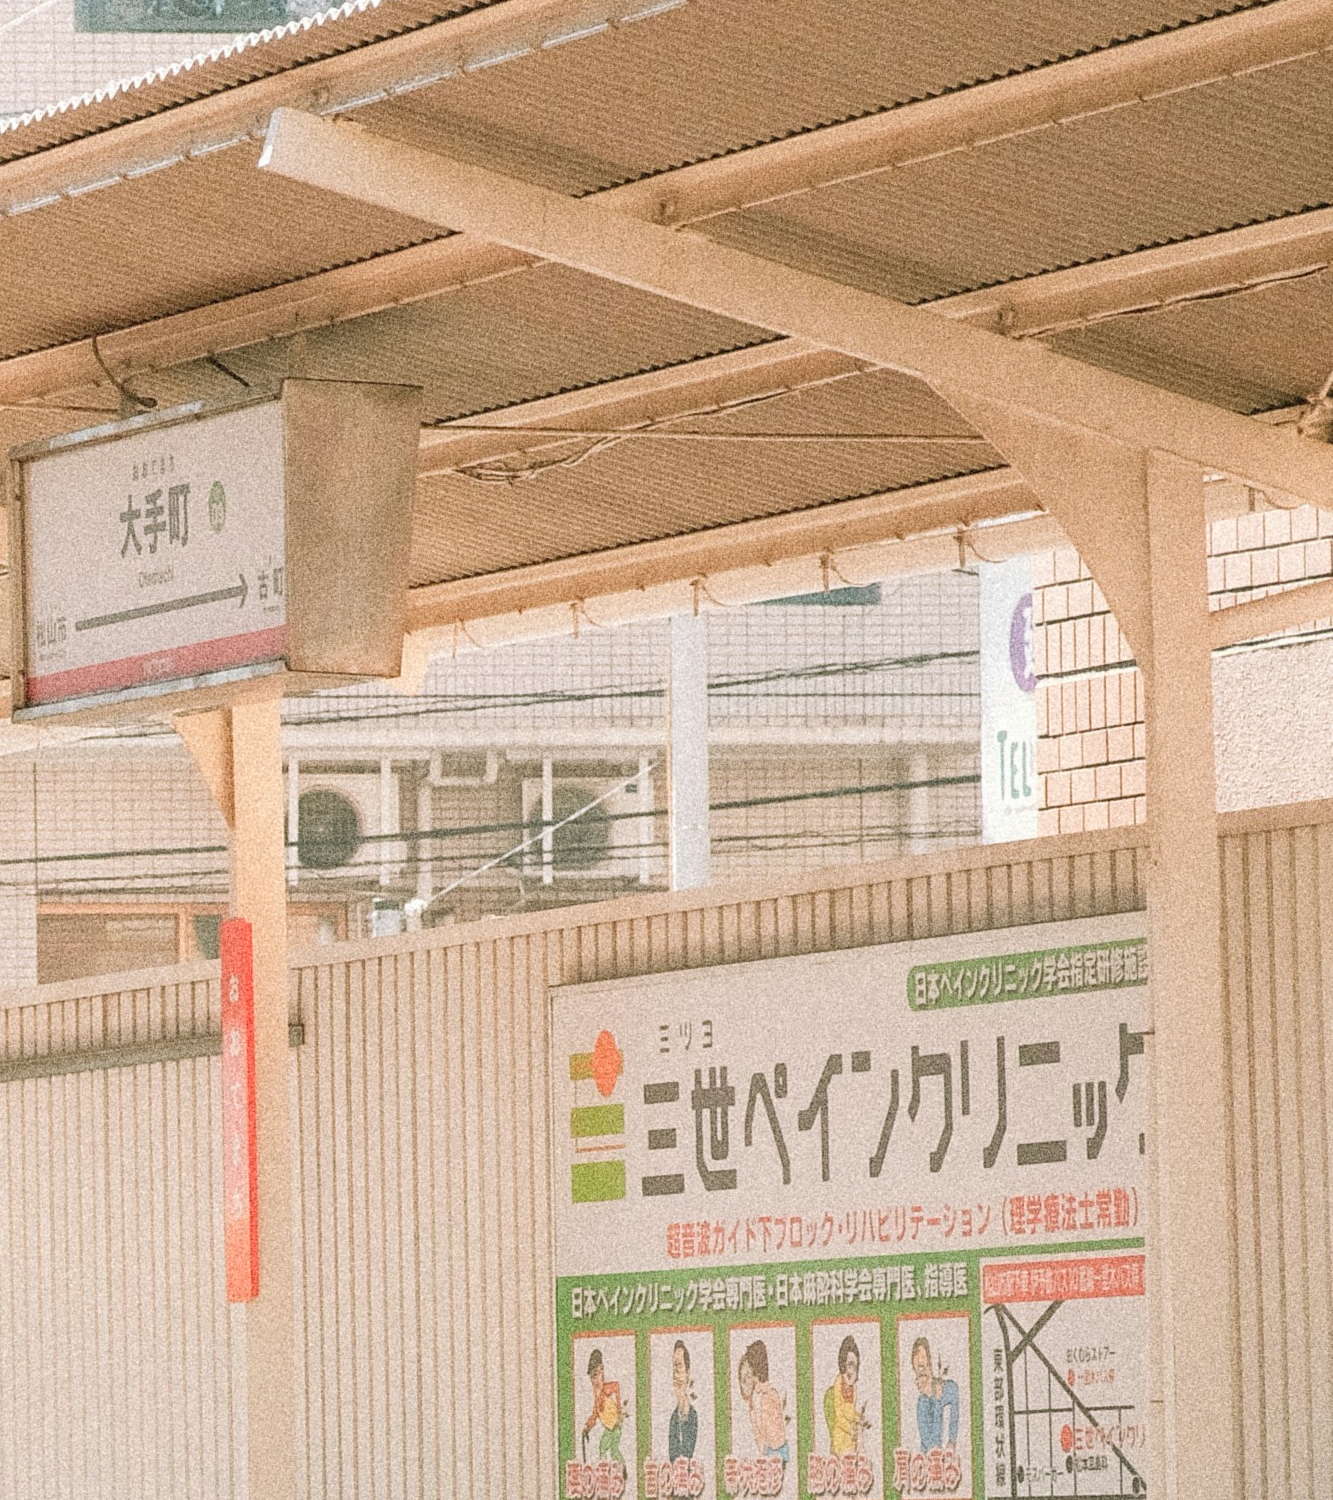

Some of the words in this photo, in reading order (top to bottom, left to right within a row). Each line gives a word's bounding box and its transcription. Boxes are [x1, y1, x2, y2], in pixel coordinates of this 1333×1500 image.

[119, 483, 190, 558] 大手町
[658, 1019, 714, 1052] ミツヨ
